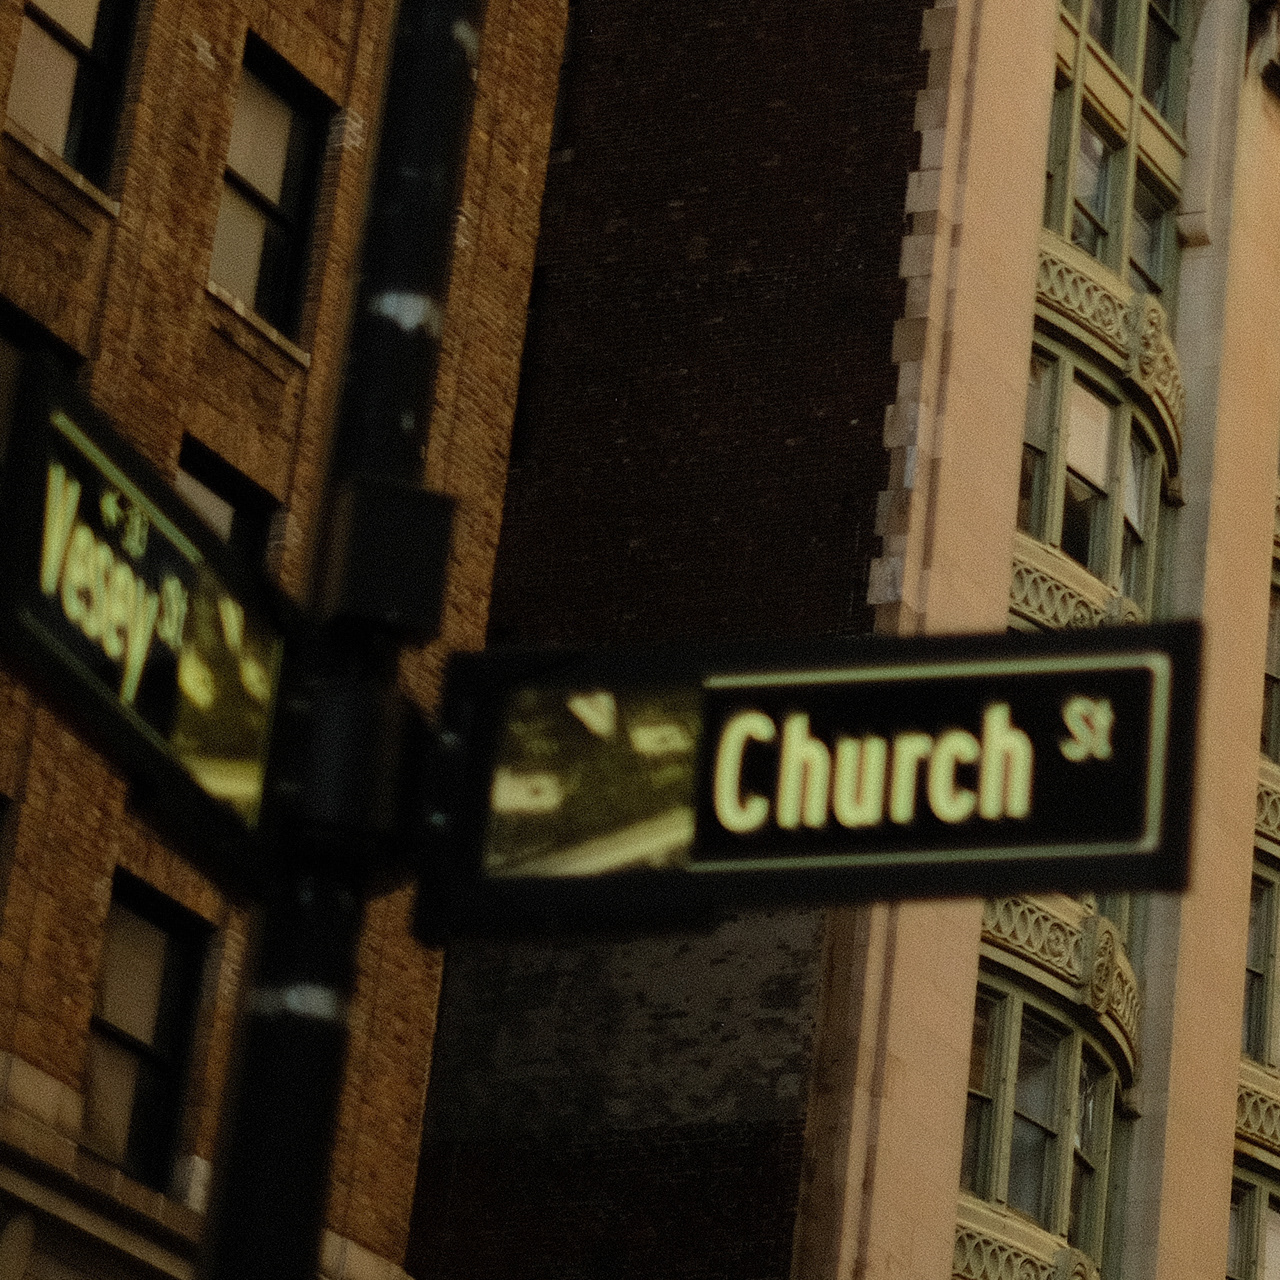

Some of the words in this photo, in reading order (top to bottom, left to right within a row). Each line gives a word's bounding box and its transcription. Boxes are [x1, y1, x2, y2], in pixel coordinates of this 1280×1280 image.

[40, 463, 159, 703] Vesey
[713, 701, 1035, 834] Church
[1060, 696, 1116, 763] St
